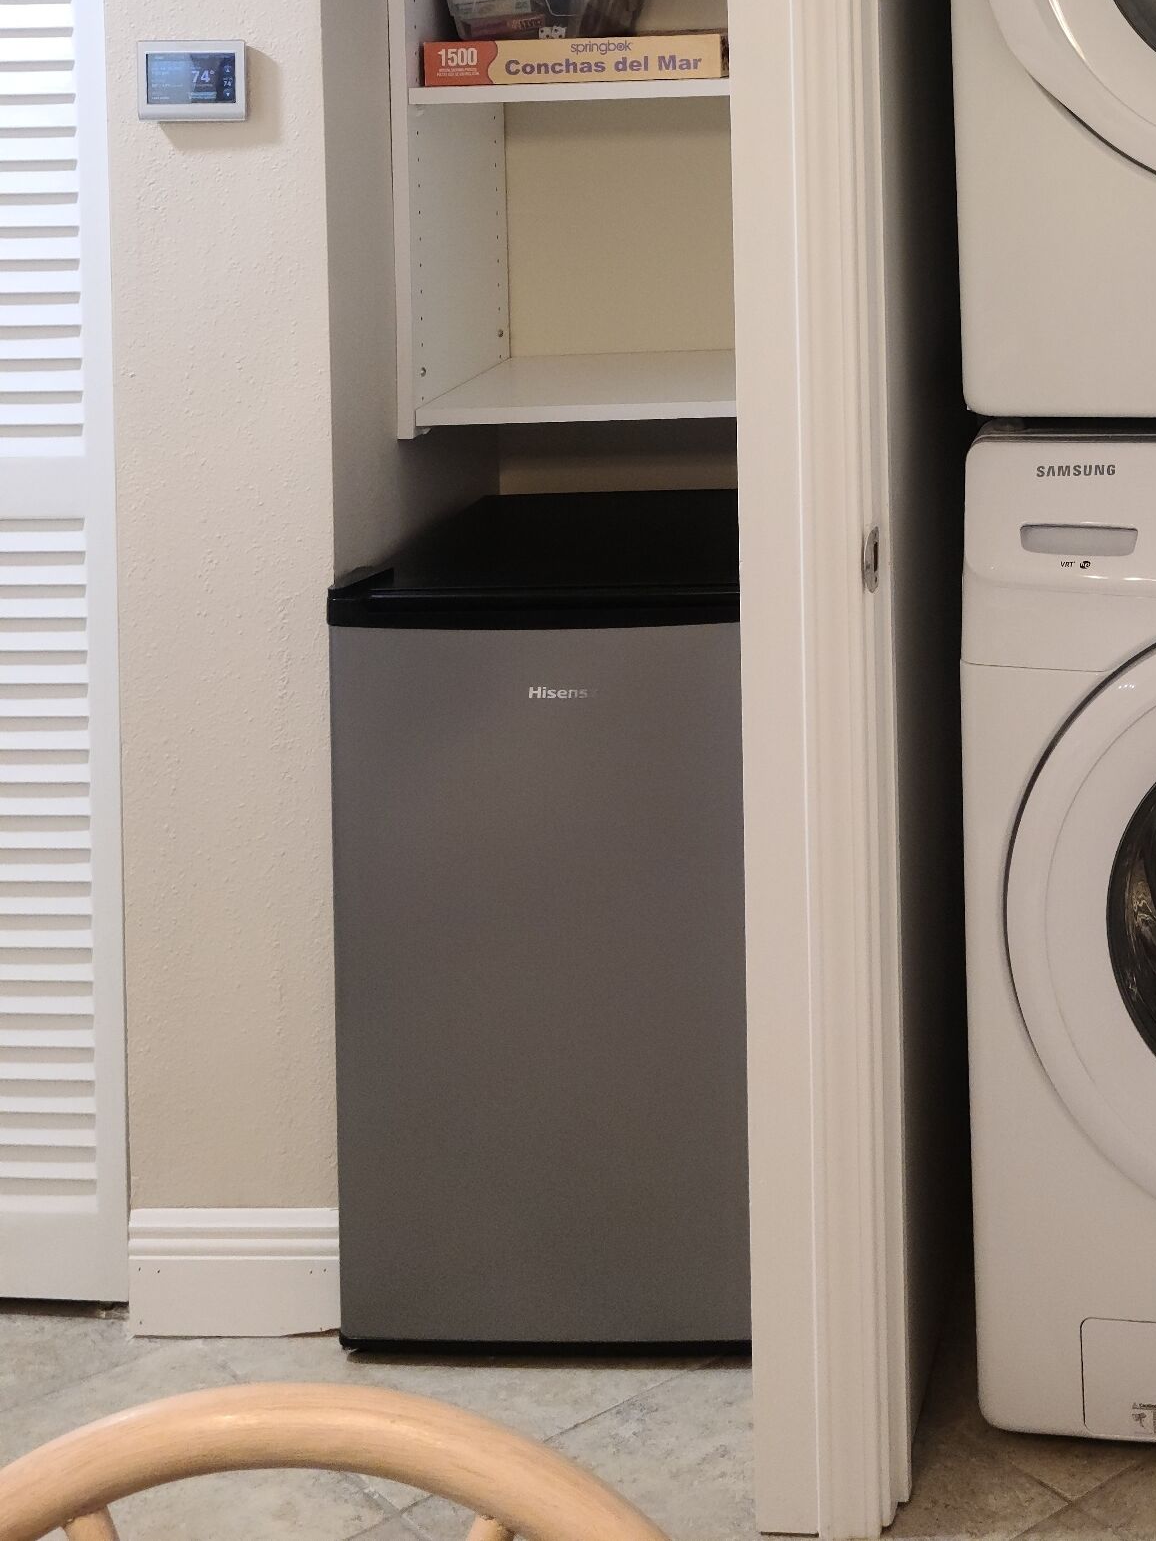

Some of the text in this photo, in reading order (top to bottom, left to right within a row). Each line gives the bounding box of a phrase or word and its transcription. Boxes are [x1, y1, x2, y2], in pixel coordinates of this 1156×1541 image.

[570, 40, 633, 55] springbok
[437, 47, 478, 66] 1500
[504, 55, 703, 76] Conchas del Mar
[1036, 464, 1116, 477] SAMSUNG
[528, 686, 598, 699] Hisens
